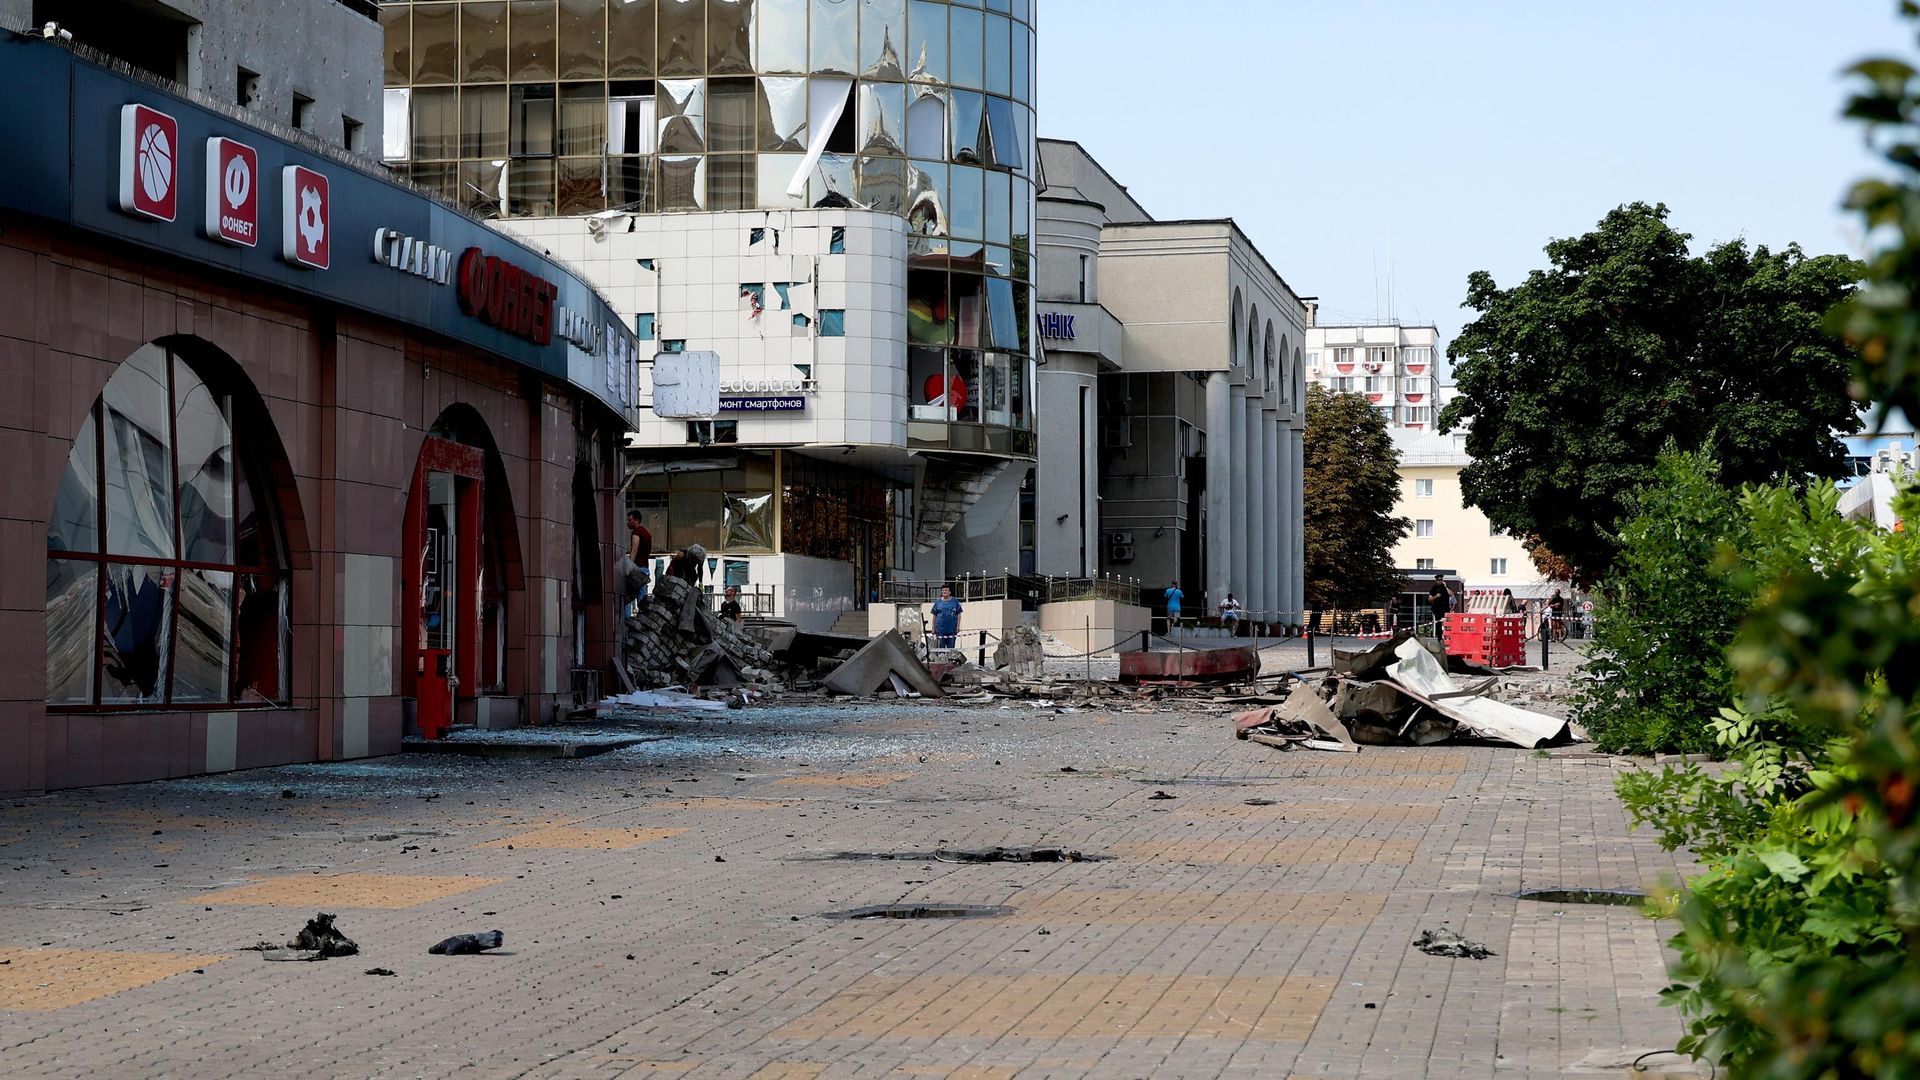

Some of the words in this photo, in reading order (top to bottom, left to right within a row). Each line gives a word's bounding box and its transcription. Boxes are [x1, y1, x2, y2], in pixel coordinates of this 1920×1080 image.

[222, 215, 254, 237] ФОНБЕТ
[374, 227, 453, 286] СТАВКИ
[459, 246, 558, 346] ФОНБЕТ
[1037, 312, 1076, 338] НК
[744, 398, 802, 410] смартфонов
